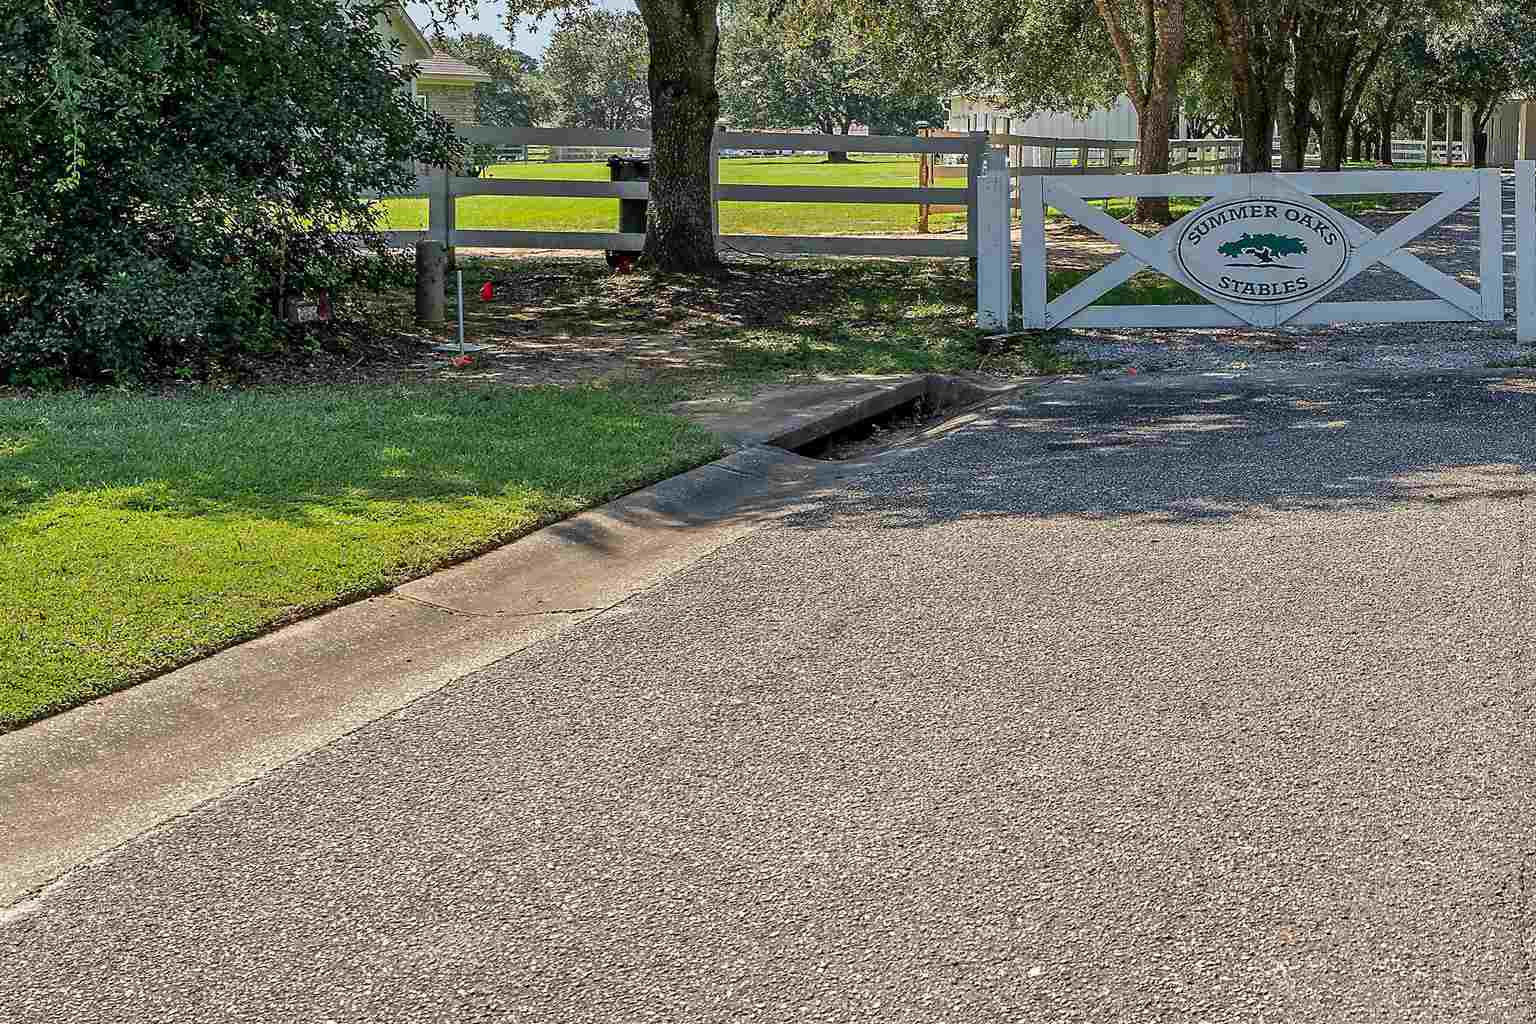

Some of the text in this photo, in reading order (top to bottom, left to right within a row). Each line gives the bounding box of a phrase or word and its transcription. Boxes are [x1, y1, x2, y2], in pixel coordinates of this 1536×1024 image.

[1188, 205, 1338, 246] SUMMER OAKS
[1218, 276, 1309, 296] STABLES
